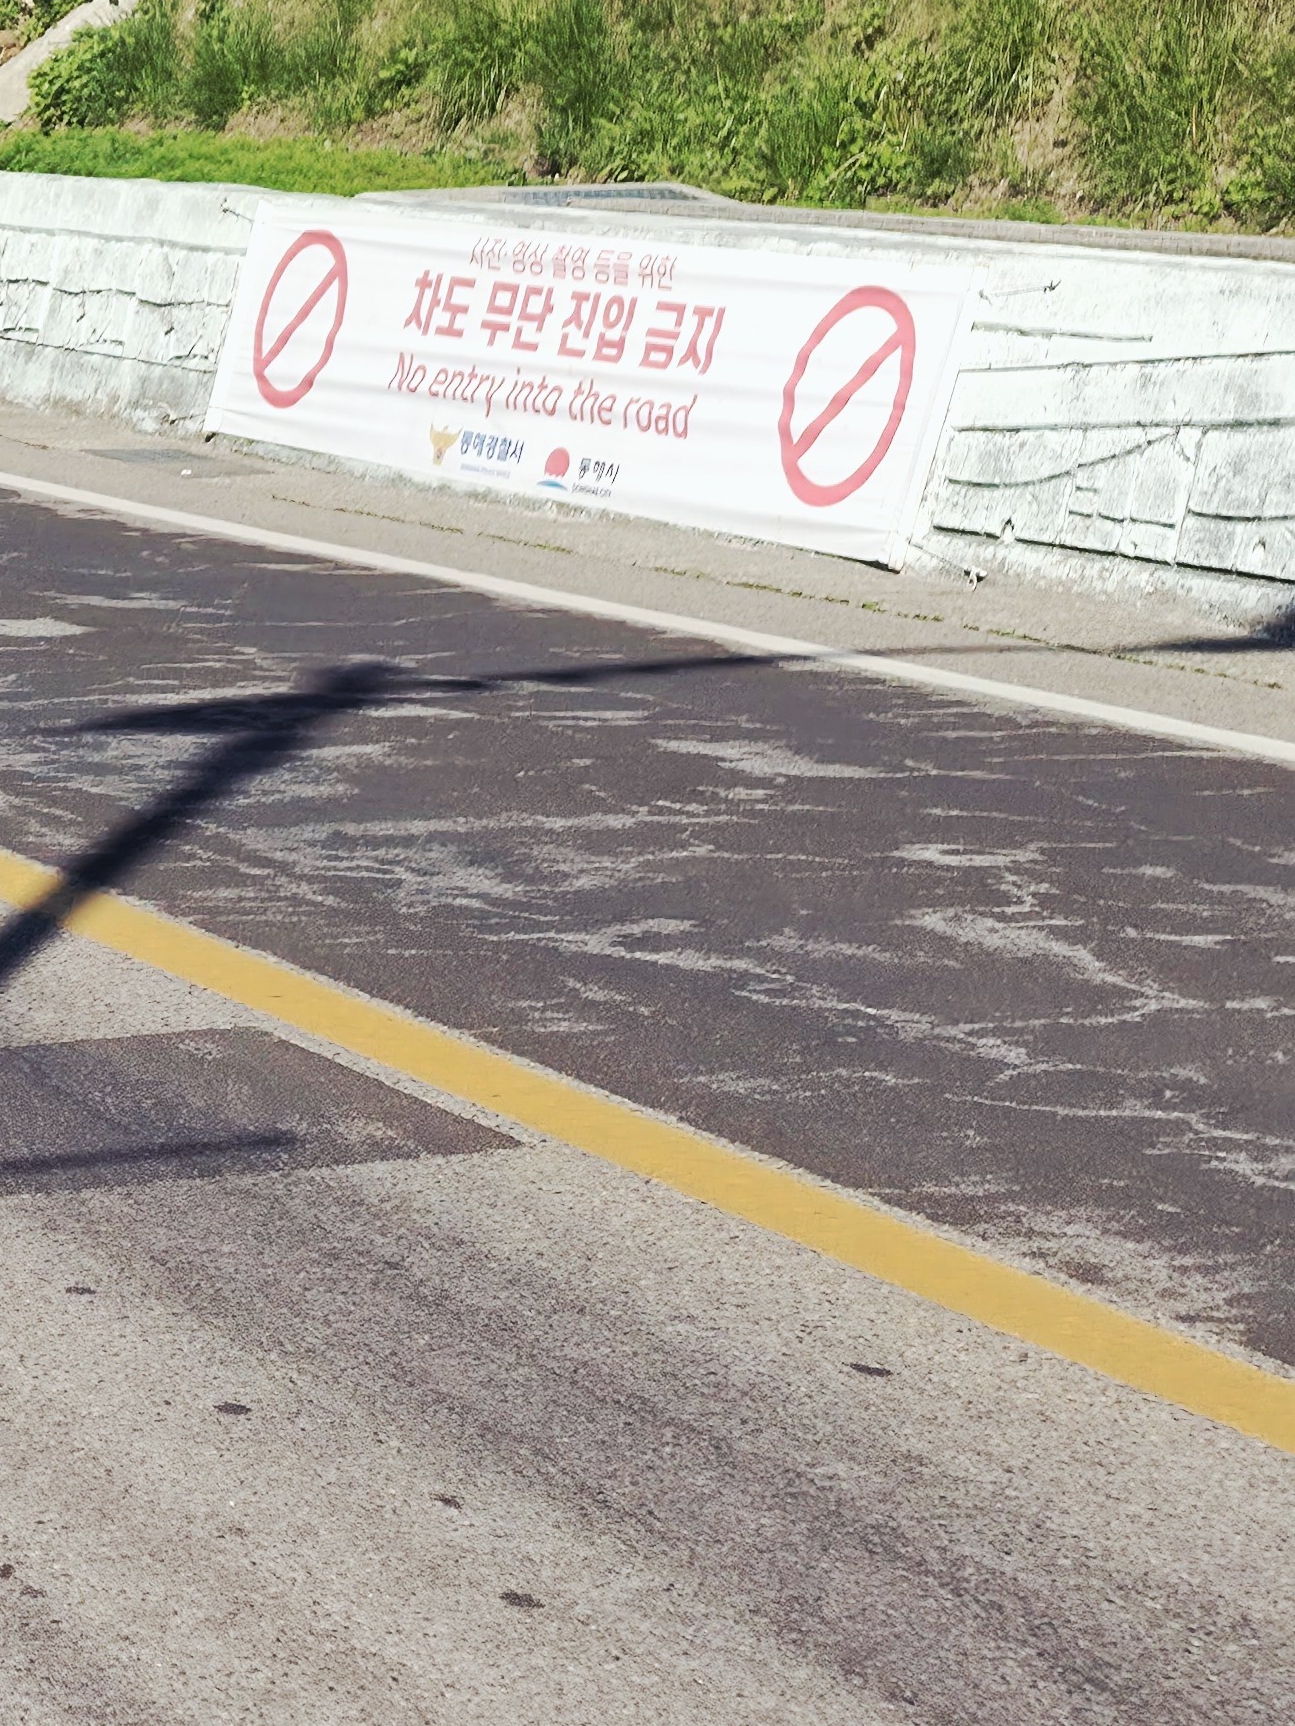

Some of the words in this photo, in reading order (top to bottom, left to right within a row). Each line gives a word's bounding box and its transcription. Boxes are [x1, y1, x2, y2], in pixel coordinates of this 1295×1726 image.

[593, 249, 633, 286] 등을
[637, 253, 678, 291] 위한
[404, 269, 477, 339] 차도
[480, 280, 555, 352] 무단
[557, 290, 639, 364] 진입
[639, 300, 727, 376] 금지
[387, 351, 428, 394] No
[428, 364, 506, 419] entry
[505, 367, 565, 417] into
[568, 378, 618, 426] the
[622, 393, 699, 440] road
